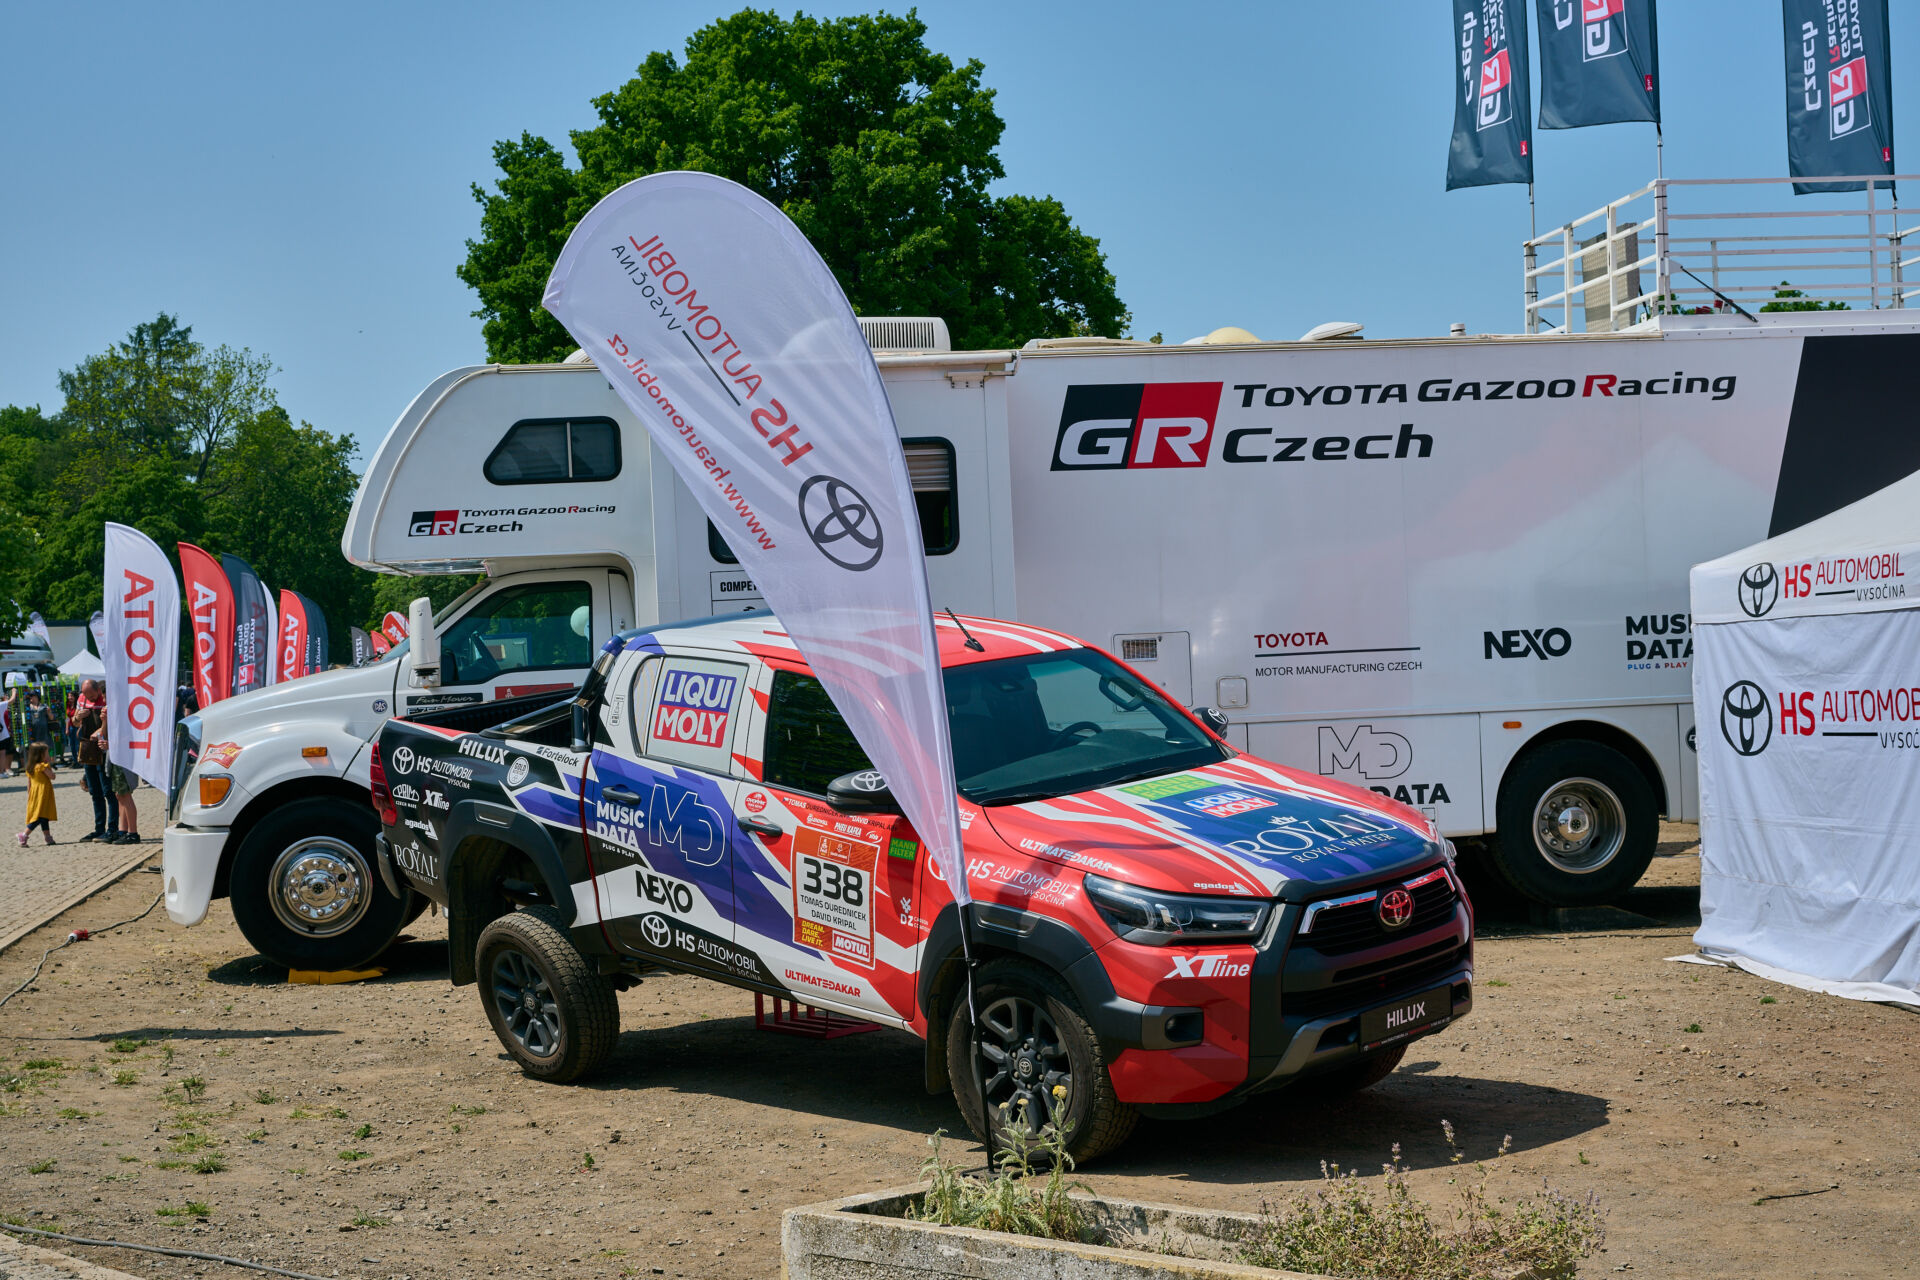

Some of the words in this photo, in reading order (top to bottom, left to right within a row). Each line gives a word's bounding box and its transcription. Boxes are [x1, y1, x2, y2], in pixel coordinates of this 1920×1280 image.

[1233, 382, 1408, 408] TOYOTA
[1416, 378, 1576, 402] GAZOO
[1581, 371, 1737, 401] Racing
[1058, 416, 1209, 466] GR
[1222, 423, 1434, 464] Czech
[462, 508, 515, 518] TOYOTA
[518, 506, 566, 516] GAZOO
[568, 504, 616, 515] Racing
[409, 520, 456, 537] GR
[459, 521, 523, 534] Czech
[1784, 563, 1812, 599] HS
[1815, 553, 1905, 586] AUTOMOBIL
[1856, 583, 1906, 601] VYSOČINA
[1625, 613, 1692, 636] MUSI
[1254, 631, 1329, 649] TOYOTA
[1483, 627, 1572, 660] NEXO
[1255, 667, 1293, 677] MOTOR
[1296, 662, 1385, 675] MANUFACTURING
[1387, 661, 1422, 672] CZECH
[1664, 661, 1688, 669] PLAY
[663, 672, 734, 709] LIQUI
[1779, 691, 1816, 737] HS
[1821, 687, 1920, 722] AUTOMOB
[656, 706, 727, 745] MOLY
[1880, 729, 1920, 749] VYSOČ
[458, 738, 511, 766] HILUX
[541, 748, 580, 767] Fortelock
[416, 755, 433, 774] HS
[431, 759, 473, 782] AUTOMOBIL
[396, 783, 416, 800] PRIM
[1126, 774, 1196, 794] MANN
[1141, 780, 1217, 798] FILTER
[789, 798, 807, 809] TOMAS
[852, 815, 868, 825] DAVID
[1185, 791, 1253, 810] LIQUI
[1207, 797, 1270, 817] MOLY
[404, 819, 429, 831] agados
[596, 800, 645, 829] MUSIC
[596, 821, 640, 849] DATA
[891, 838, 916, 851] MANN
[1221, 813, 1399, 863] ROYAL
[602, 842, 616, 852] PLUG
[621, 849, 635, 859] PLAY
[889, 847, 915, 859] FILTER
[1291, 843, 1340, 863] ROYAL
[1340, 832, 1396, 848] WATER
[394, 844, 438, 880] ROYAL
[803, 856, 864, 907] 338
[966, 858, 995, 879] HS
[993, 864, 1075, 897] AUTOMOBIL
[1193, 881, 1235, 890] agados
[635, 869, 693, 914] NEXO
[1023, 887, 1066, 907] VYSOČINA
[800, 894, 824, 908] TOMAS
[824, 902, 867, 921] OUREDNICEK
[801, 920, 825, 933] DREAM.
[811, 909, 832, 923] DAVID
[832, 916, 857, 931] KRIPAL
[801, 927, 820, 938] DARE.
[801, 934, 815, 945] LIVE
[675, 929, 696, 953] HS
[697, 938, 760, 974] AUTOMOBIL
[835, 936, 869, 957] MOTUL
[1163, 954, 1250, 978] XTline
[1386, 1001, 1426, 1029] HILUX
